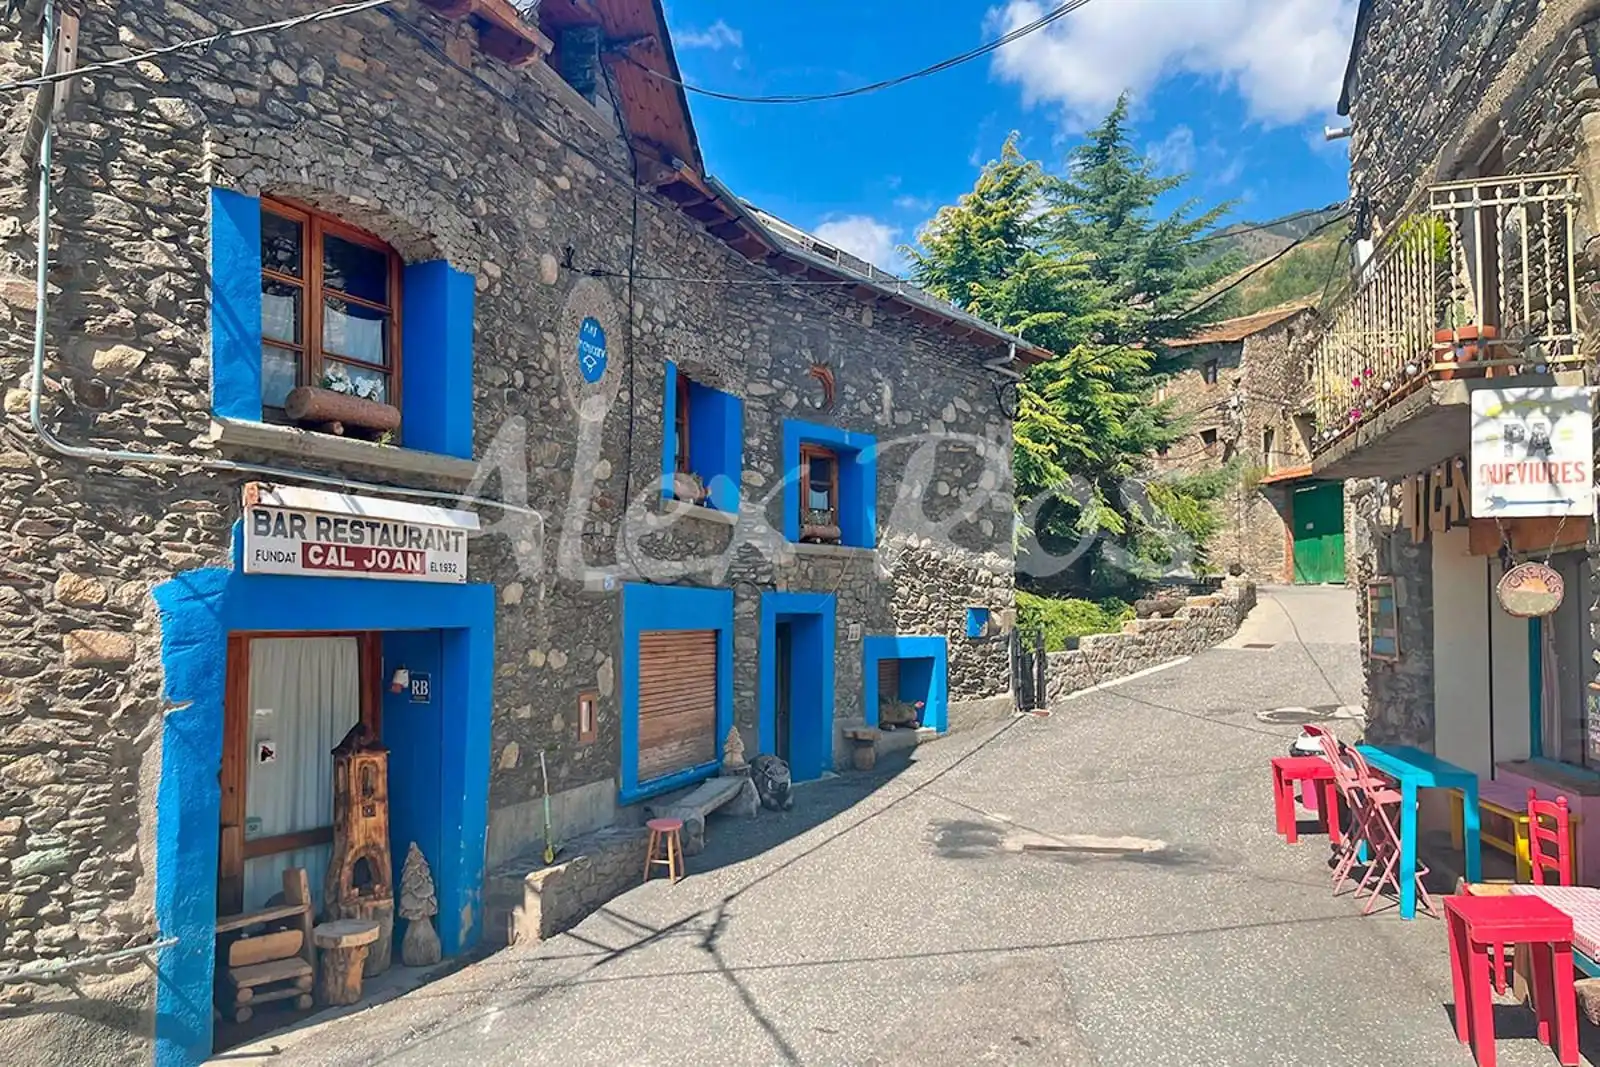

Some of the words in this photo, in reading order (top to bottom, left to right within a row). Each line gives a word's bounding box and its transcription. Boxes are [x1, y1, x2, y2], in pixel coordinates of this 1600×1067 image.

[1503, 422, 1555, 458] PA
[252, 509, 308, 541] BAR
[315, 516, 465, 553] RESTAURANT
[255, 549, 297, 564] FUNDAT
[307, 544, 355, 567] CAL
[362, 549, 422, 571] JOAN
[411, 679, 429, 696] RB
